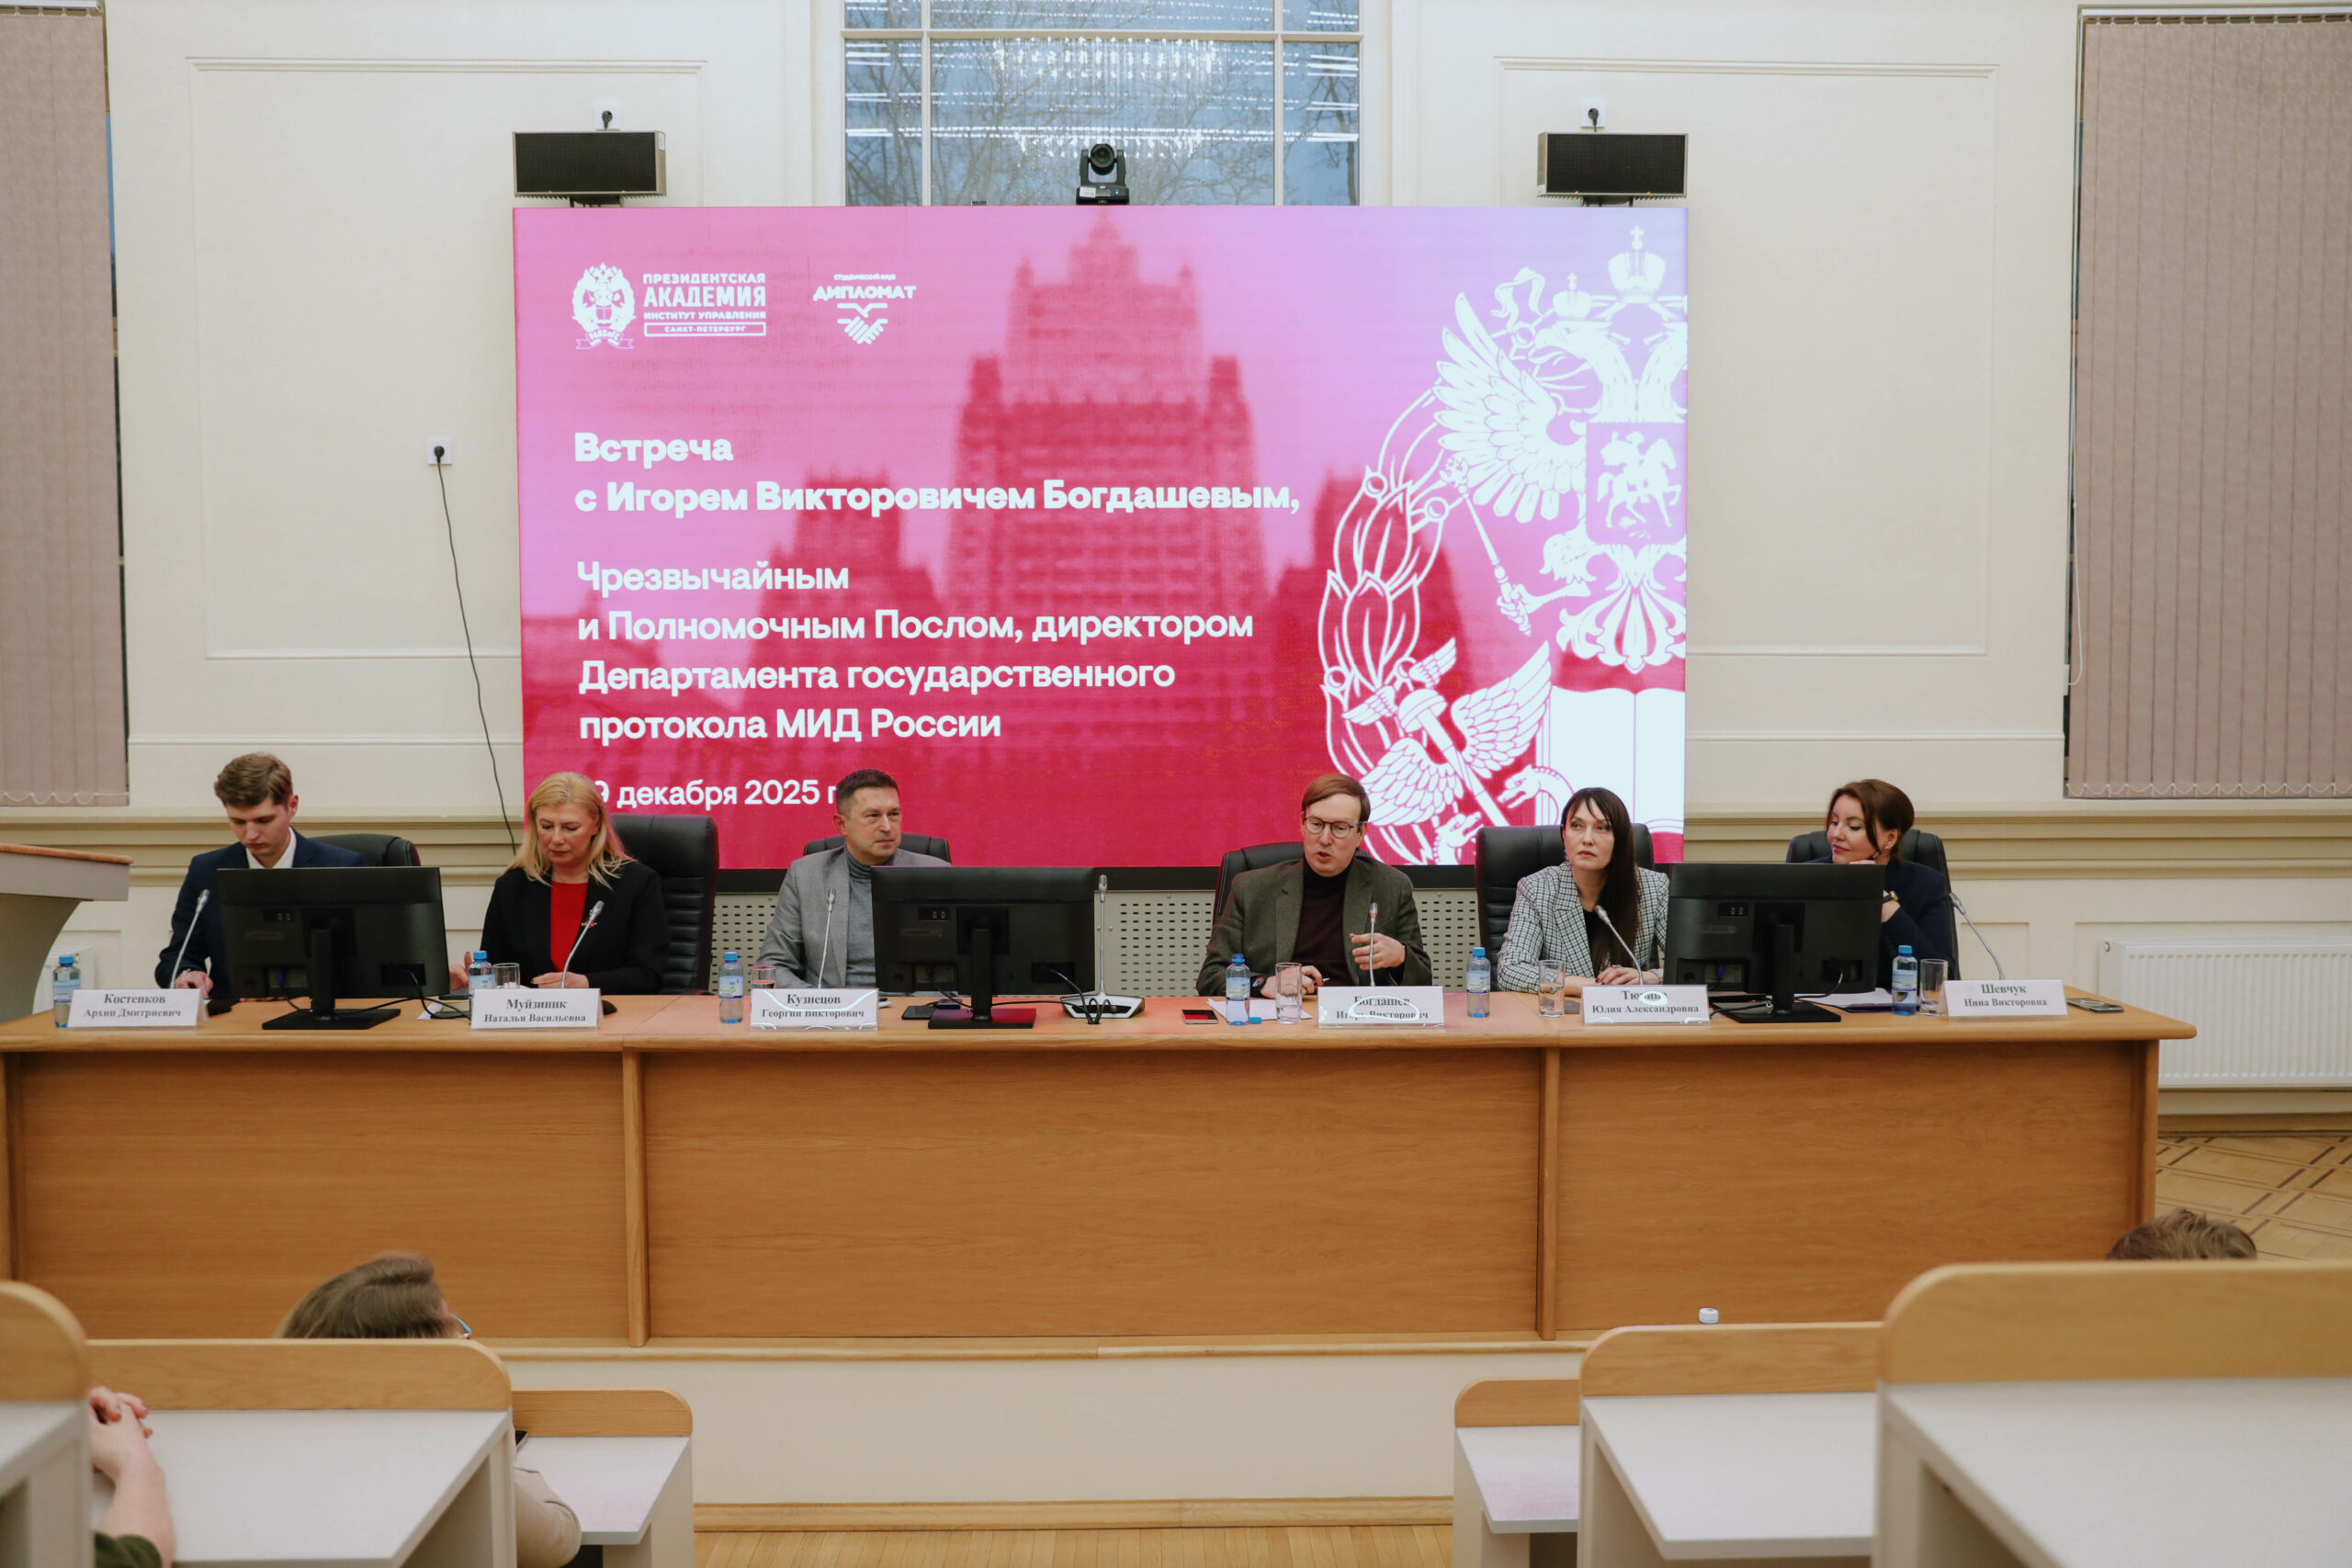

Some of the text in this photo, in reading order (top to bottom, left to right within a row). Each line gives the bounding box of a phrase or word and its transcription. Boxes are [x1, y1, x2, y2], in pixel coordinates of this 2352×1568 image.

[642, 273, 766, 285] ПРЕЗИДЕНТСКАЯ
[643, 286, 766, 308] АКАДЕМИЯ
[812, 286, 917, 301] ДИПЛОМАТ
[643, 311, 766, 320] ИНСТИТУТ УПРАВЛЕНИЯ
[663, 325, 746, 333] САНКТ-ПЕТЕРБУРГ
[574, 432, 734, 469] Встреча
[574, 479, 1300, 519] с Игорем Викторовичем Богдашевым,
[577, 560, 849, 598] Чрезвычайным
[578, 609, 1253, 645] и Полномочным Послом, директором
[579, 660, 1175, 697] Департамента государственного
[580, 708, 1001, 746] протокола МИД России
[616, 779, 737, 811] декабря
[744, 779, 820, 805] 2025
[1981, 984, 2028, 996] Шевчук
[104, 994, 166, 1004] Костенков
[786, 994, 841, 1006] Кузнецов
[1964, 998, 2048, 1008] Нина Викторовна
[118, 1009, 182, 1019] Дмитриевич
[1592, 1005, 1700, 1015] Юлия Александровна
[484, 1014, 586, 1022] Наталья Васильевна
